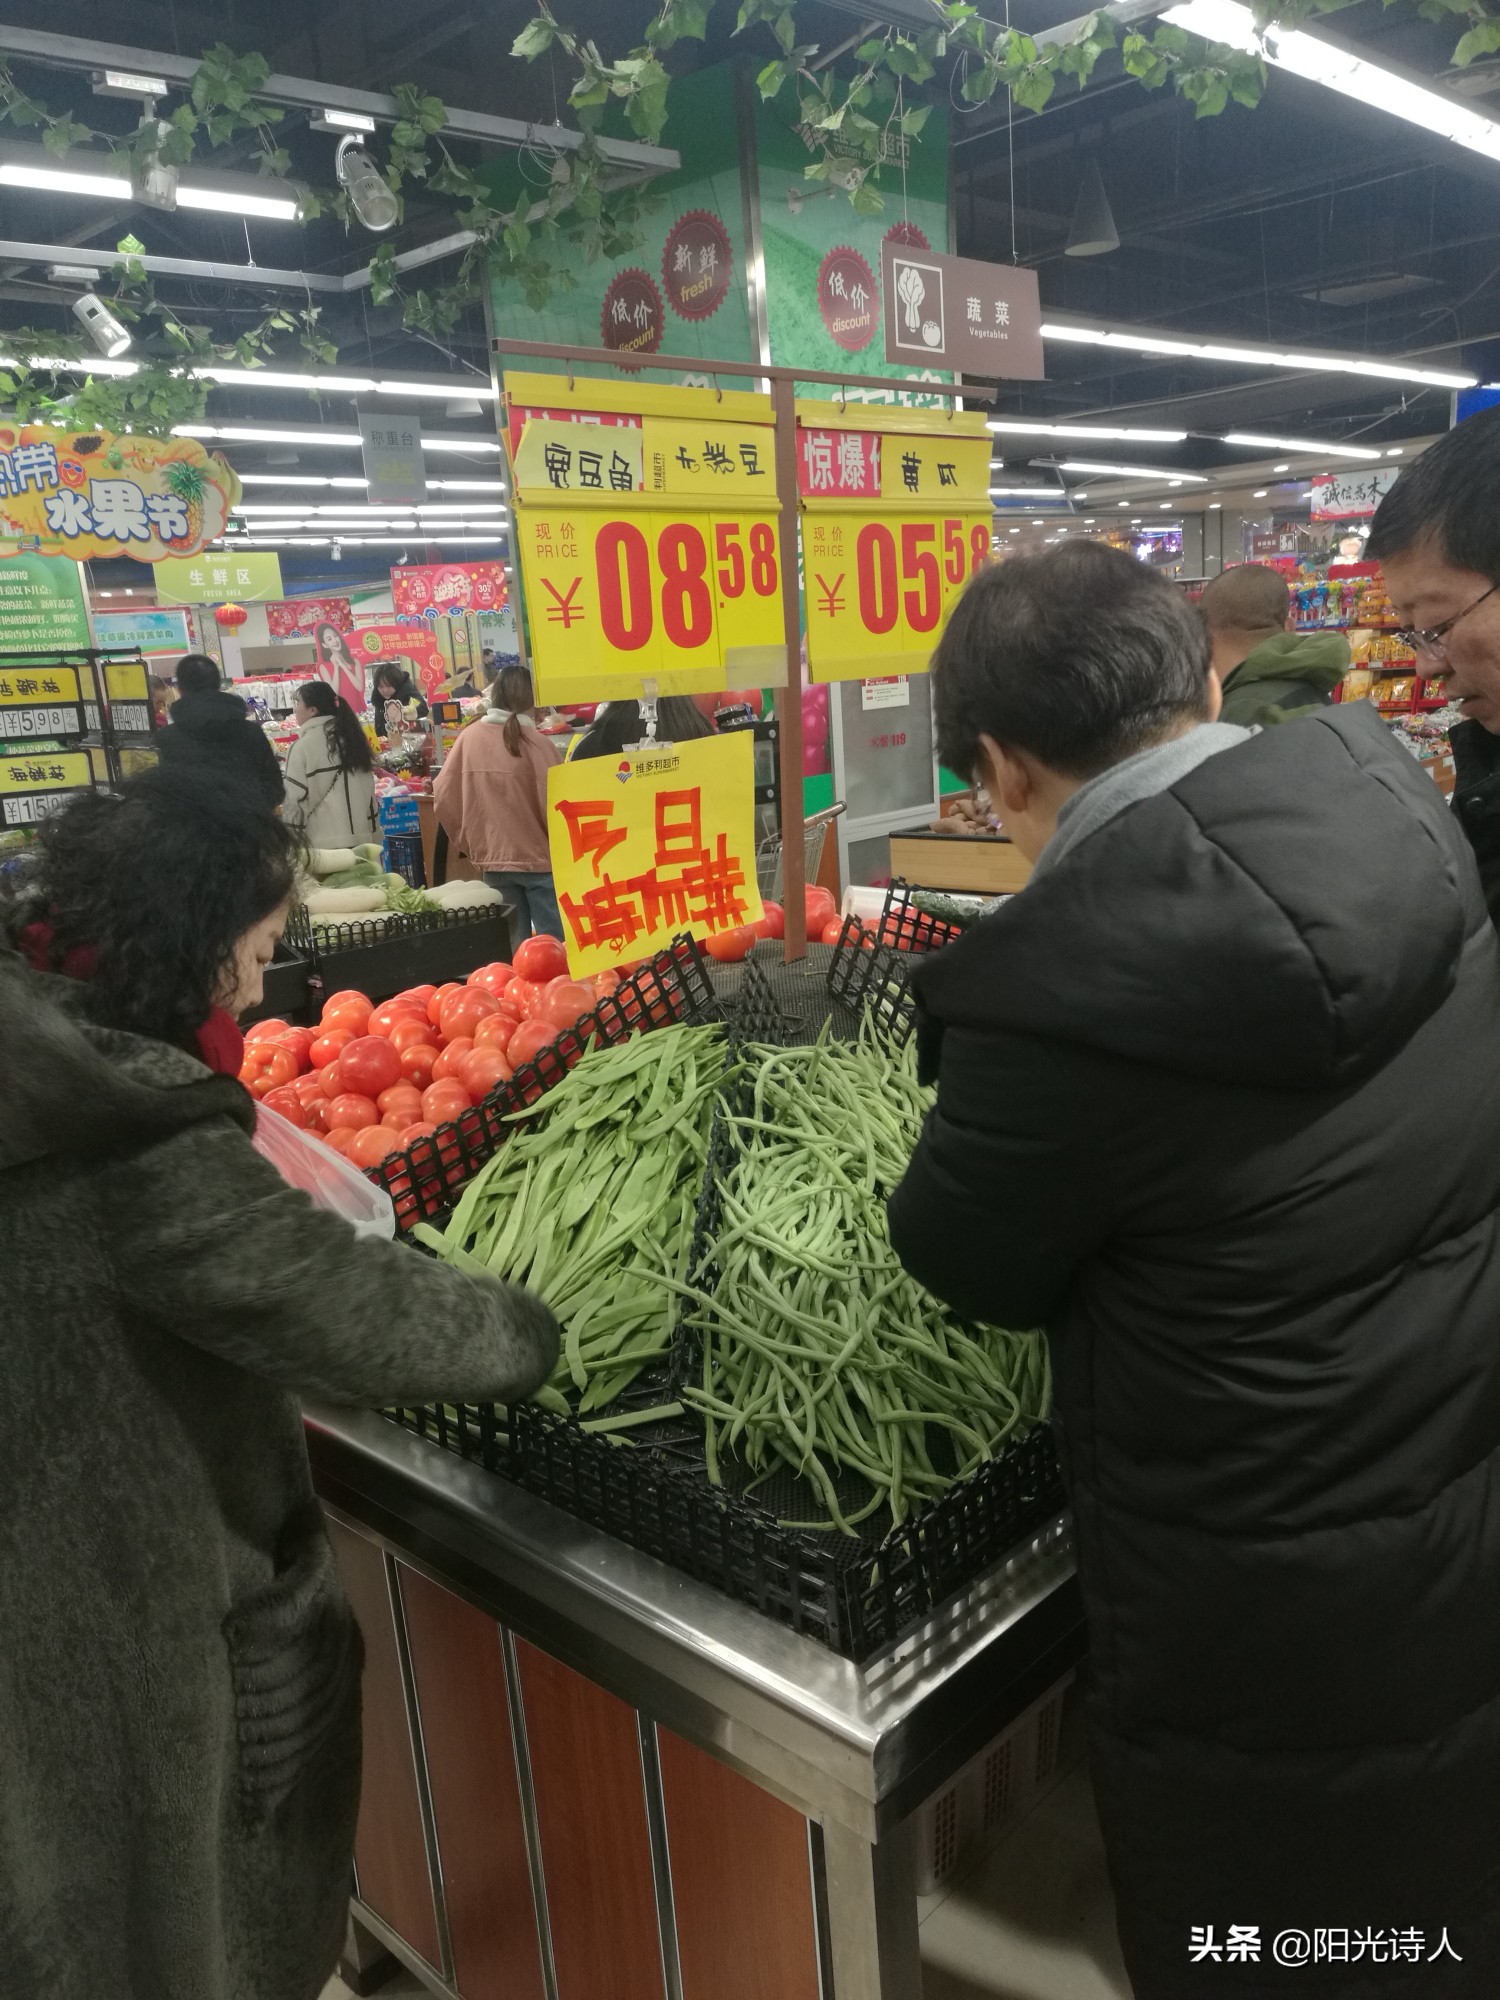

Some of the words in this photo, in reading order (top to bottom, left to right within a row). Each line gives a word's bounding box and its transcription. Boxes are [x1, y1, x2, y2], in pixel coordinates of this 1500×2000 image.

[673, 243, 719, 275] 新鲜
[680, 274, 714, 303] fresh
[829, 271, 870, 313] 低价
[611, 298, 653, 330] 低价
[967, 297, 1010, 326] 蔬菜
[832, 313, 871, 333] discount
[969, 327, 1008, 340] Vegetables
[371, 430, 414, 447] 称重台
[902, 451, 958, 493] 黄瓜
[44, 478, 190, 540] 水果节
[535, 521, 575, 541] 现价
[813, 526, 843, 541] 现价
[536, 543, 579, 559] PRICE
[814, 545, 844, 558] PRICE
[189, 569, 251, 586] 生鲜区
[892, 733, 906, 747] 119
[636, 756, 680, 774] 维多利超市
